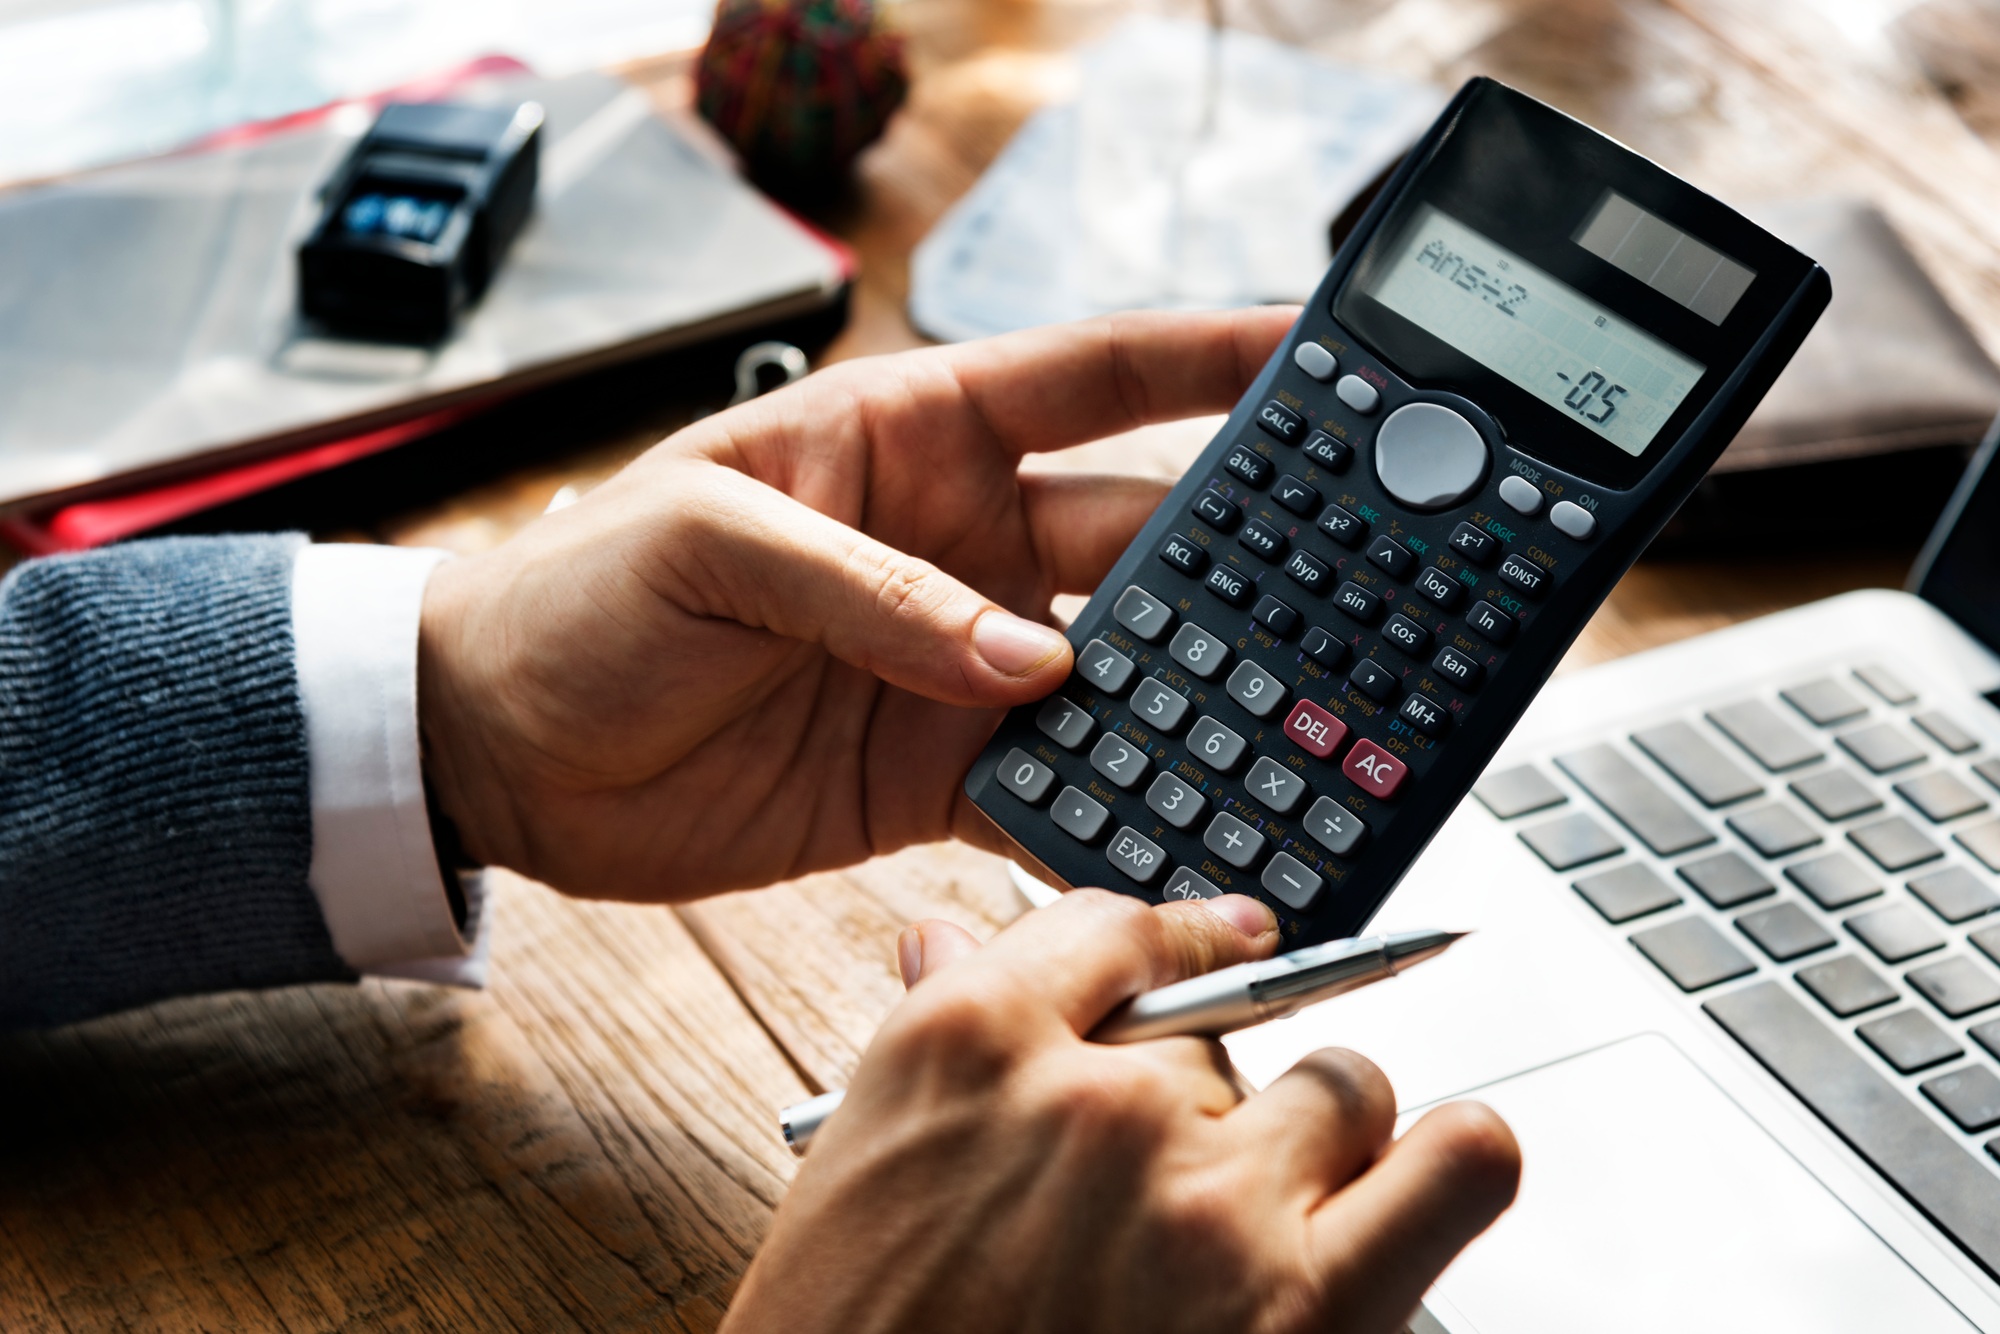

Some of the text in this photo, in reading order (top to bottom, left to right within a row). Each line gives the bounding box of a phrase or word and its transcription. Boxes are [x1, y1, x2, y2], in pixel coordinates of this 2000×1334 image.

[1356, 365, 1389, 390] ALPHA
[1557, 371, 1627, 423] -0.5
[1261, 407, 1296, 435] CALC
[1509, 458, 1565, 497] MODE CLR
[1240, 497, 1250, 508] A
[1578, 494, 1600, 512] ON
[1358, 504, 1381, 524] DEC
[1188, 527, 1211, 546] STO
[1288, 526, 1298, 538] B
[1486, 519, 1517, 543] LOGIC
[1165, 541, 1192, 566] RCL
[1407, 535, 1429, 555] HEX
[1336, 558, 1347, 569] C
[1527, 545, 1558, 568] CONV
[1291, 555, 1319, 582] hyp
[1459, 569, 1479, 587] BIN
[1502, 561, 1541, 589] CONST
[1210, 570, 1242, 596] ENG
[1423, 572, 1449, 599] log
[1178, 598, 1191, 611] M
[1342, 592, 1367, 611] sin
[1384, 588, 1395, 600] D
[1500, 595, 1523, 613] OCT
[1131, 601, 1154, 622] 7
[1391, 623, 1417, 644] cos
[1436, 622, 1447, 634] E
[1108, 631, 1135, 653] MAT
[1236, 637, 1248, 649] G
[1254, 631, 1274, 648] arg
[1351, 634, 1363, 647] X
[1187, 639, 1208, 662] 8
[1486, 655, 1497, 665] F
[1094, 656, 1115, 677] 4
[1302, 661, 1323, 679] Abs
[1402, 666, 1413, 678] Y
[1442, 654, 1468, 678] tan
[1165, 668, 1188, 688] VCT
[1243, 677, 1264, 699] 9
[1296, 676, 1306, 686] T
[1147, 692, 1170, 715] 5
[1327, 697, 1348, 716] INS
[1347, 691, 1377, 716] Conjg
[1406, 700, 1436, 725] M+
[1449, 699, 1464, 713] M
[1057, 711, 1073, 732] 1
[1293, 711, 1329, 747] DEL
[1388, 720, 1408, 735] DT
[1121, 722, 1149, 746] S-VAR
[1204, 732, 1226, 754] 6
[1035, 745, 1058, 764] Rnd
[1386, 737, 1411, 755] OFF
[1106, 748, 1129, 772] 2
[1287, 754, 1307, 770] nPr
[1355, 754, 1393, 784] AC
[1014, 763, 1035, 785] 0
[1178, 761, 1205, 785] DISTR
[1087, 780, 1116, 804] Ran#
[1162, 786, 1185, 810] 3
[1347, 795, 1368, 812] nCr
[1115, 836, 1154, 867] EXP
[1201, 860, 1226, 882] DRG
[1172, 880, 1209, 901] An
[1288, 921, 1300, 935] %
